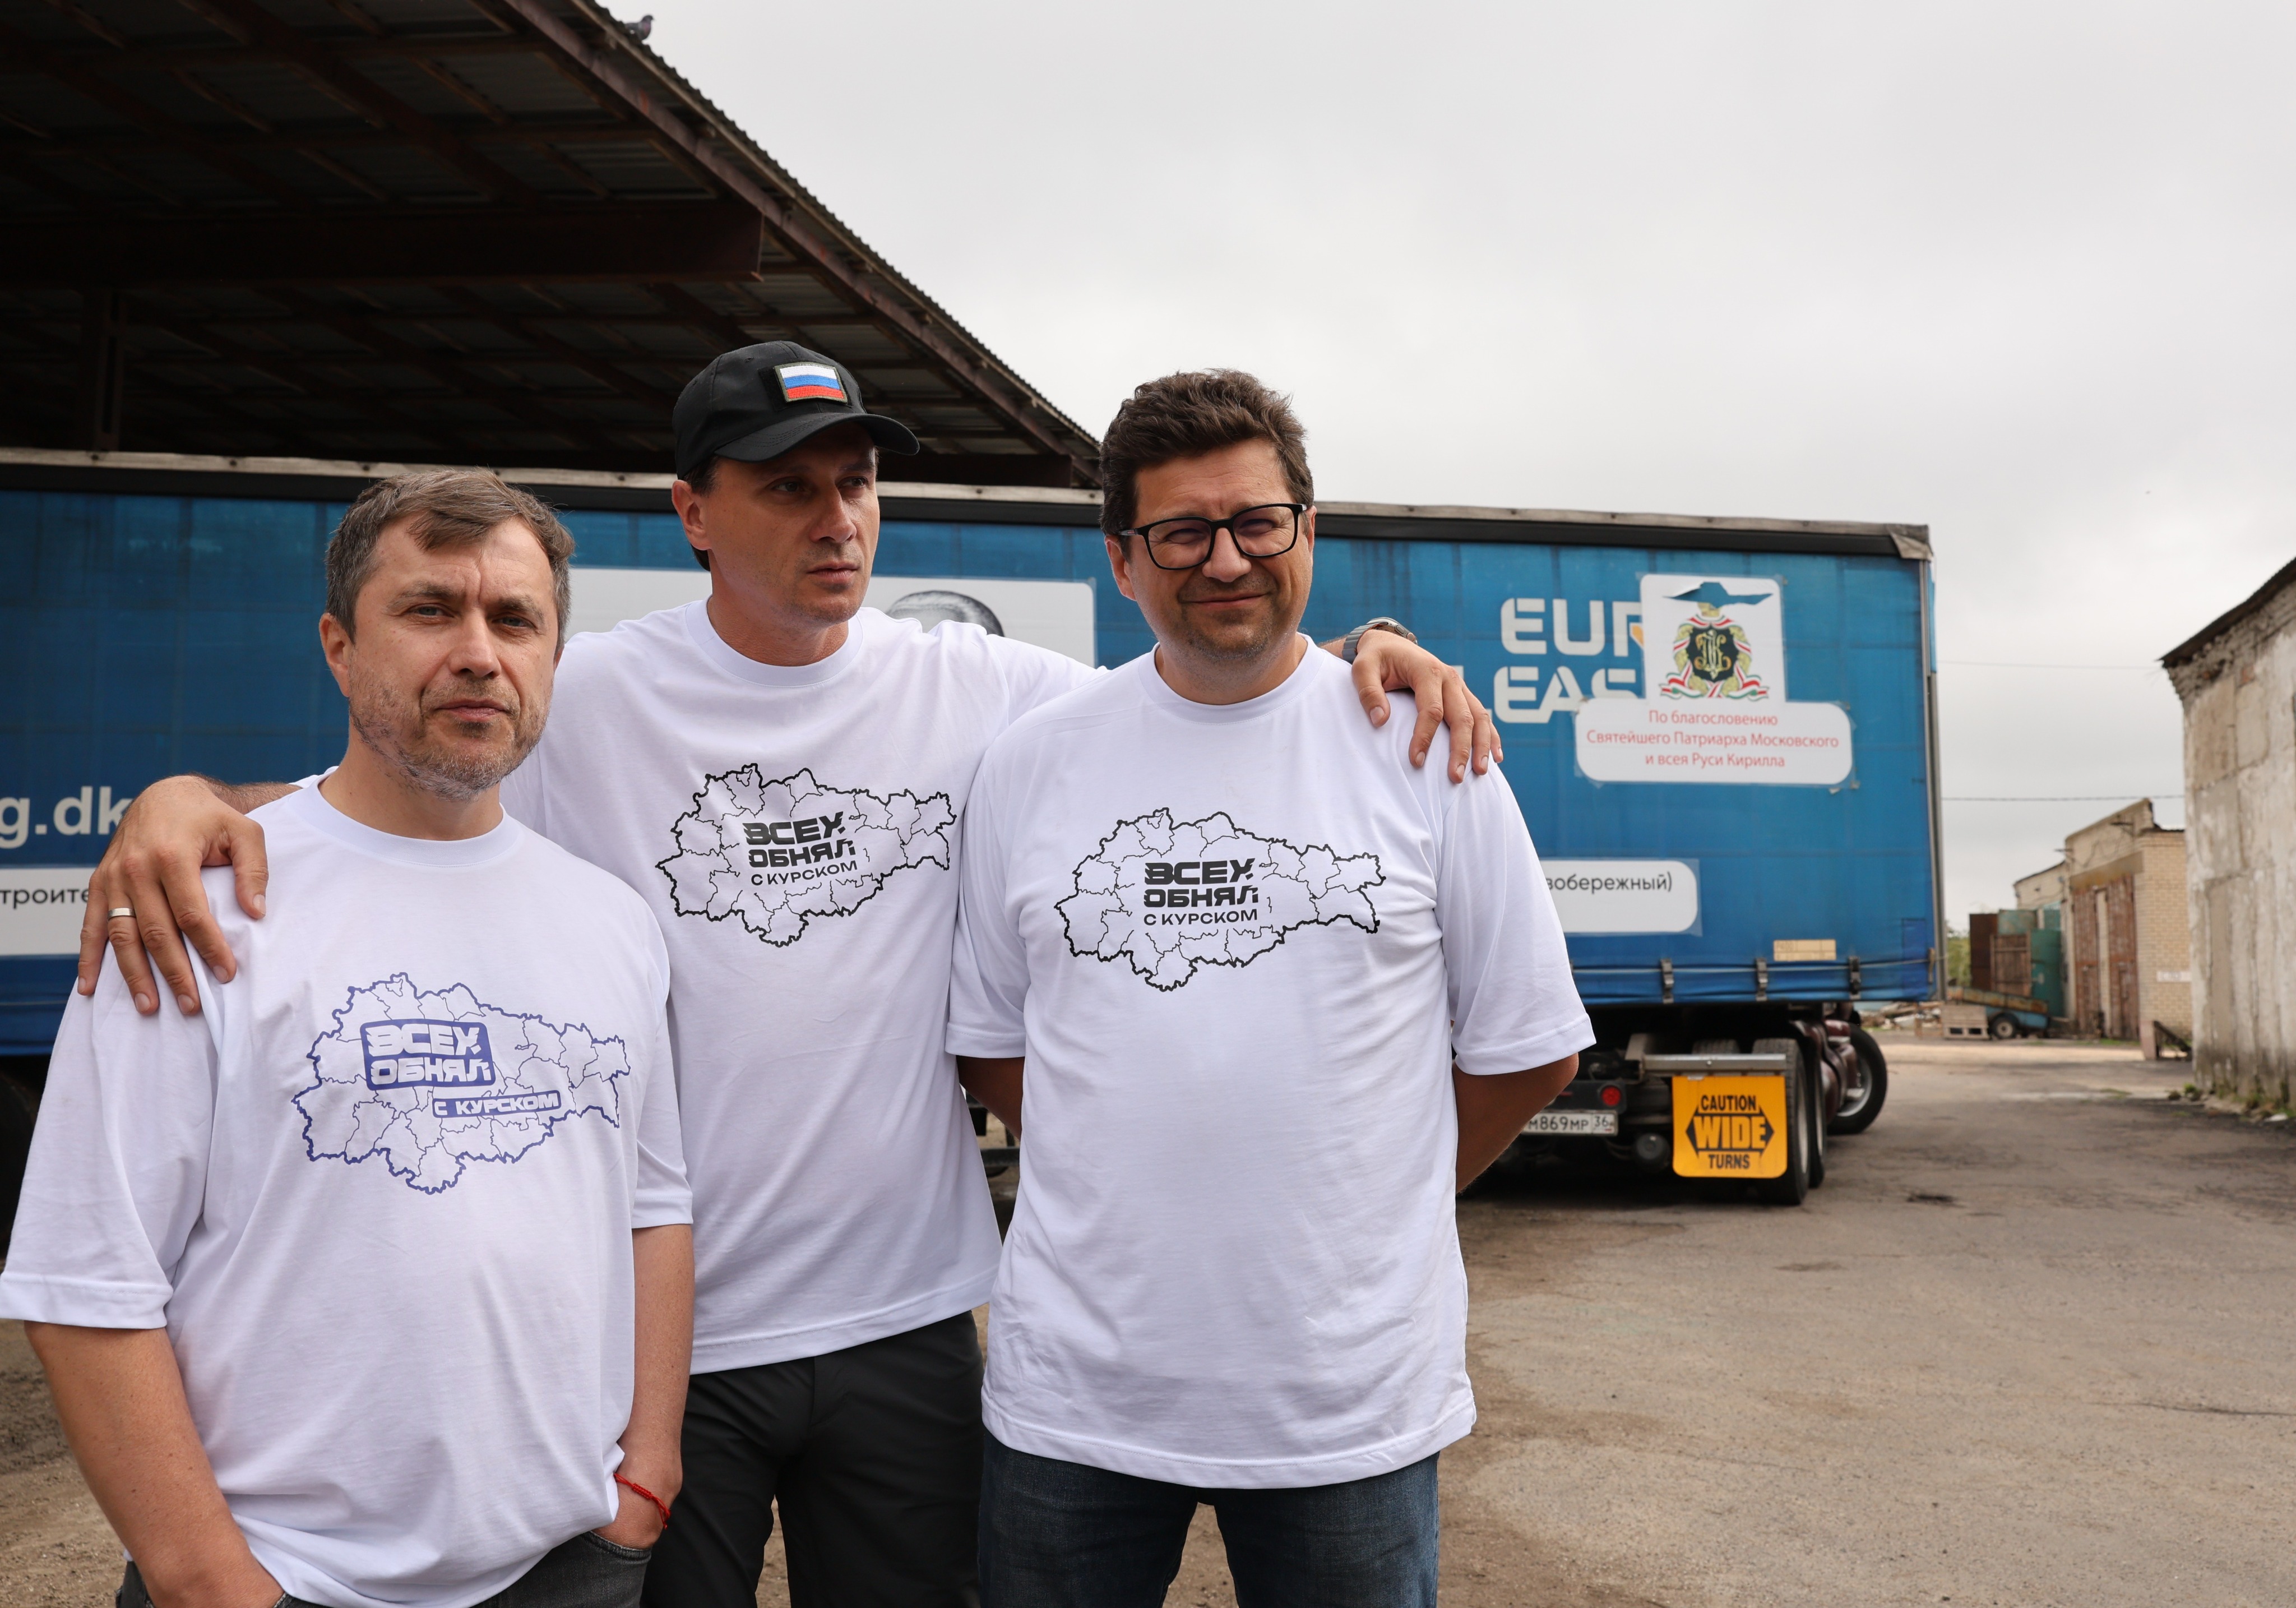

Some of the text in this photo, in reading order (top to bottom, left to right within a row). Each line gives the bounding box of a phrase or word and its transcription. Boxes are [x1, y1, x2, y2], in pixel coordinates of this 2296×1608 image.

[1450, 666, 1639, 723] EAS
[1649, 710, 1778, 726] По благословению
[1586, 730, 1839, 747] Святейшего Патриарха Московского
[1645, 753, 1785, 769] и всея Руси Кирилла
[743, 811, 846, 845] ВСЕХ
[748, 838, 855, 868] ОБНЯЛ
[751, 860, 858, 886] С КУРСКОМ
[1144, 858, 1256, 885] ВСЕХ
[1144, 885, 1259, 908] ОБНЯЛ
[1144, 908, 1258, 926] С КУРСКОМ
[365, 1024, 482, 1057] ВСЕХ
[370, 1057, 493, 1085] ОБНЯЛ
[434, 1094, 559, 1116] С КУРСКОМ
[1701, 1095, 1756, 1111] CAUTION
[1594, 1116, 1610, 1128] 36
[1693, 1116, 1766, 1149] WIDE
[1709, 1154, 1750, 1169] TURNS
